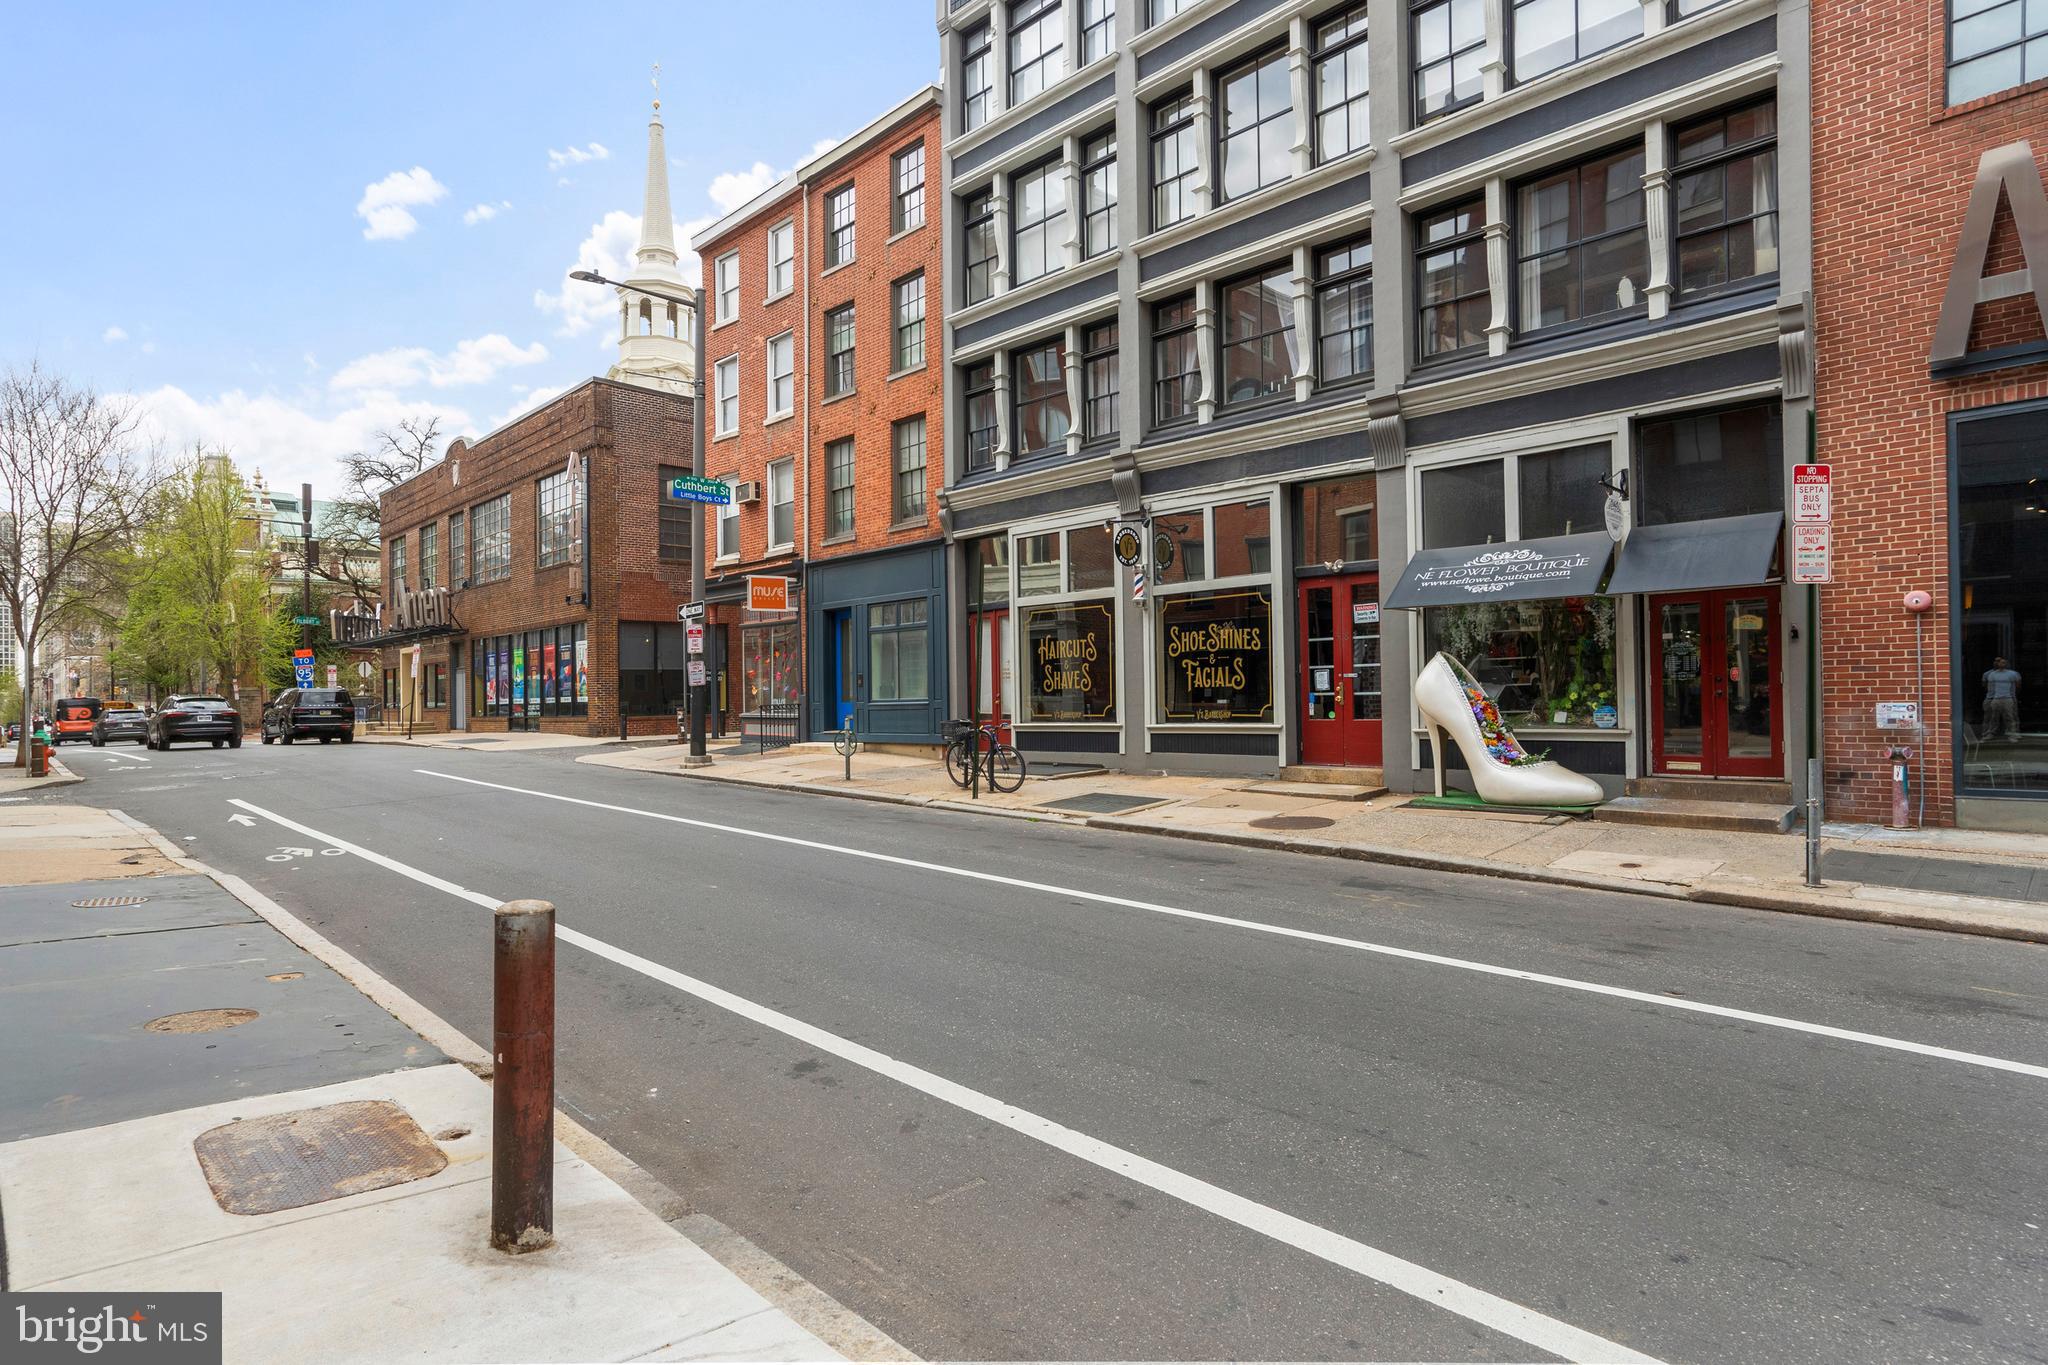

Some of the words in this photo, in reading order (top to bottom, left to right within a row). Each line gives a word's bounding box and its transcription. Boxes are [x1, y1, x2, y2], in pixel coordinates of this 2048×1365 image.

[1806, 466, 1817, 475] NO
[1796, 474, 1828, 483] STOPPING
[674, 479, 717, 494] Cuthbert
[720, 486, 729, 496] St
[1799, 486, 1824, 494] SEPTA
[680, 491, 696, 499] Little
[697, 493, 712, 502] Boys
[1801, 503, 1822, 511] ONLY
[1798, 528, 1826, 536] LOADING
[1414, 571, 1435, 581] NE
[1507, 557, 1590, 573] BOUTIQUE
[392, 575, 448, 630] Arden
[1209, 653, 1215, 664] &
[298, 669, 311, 678] 95
[1043, 663, 1091, 692] SHAVES
[1182, 657, 1245, 692] FACIALS
